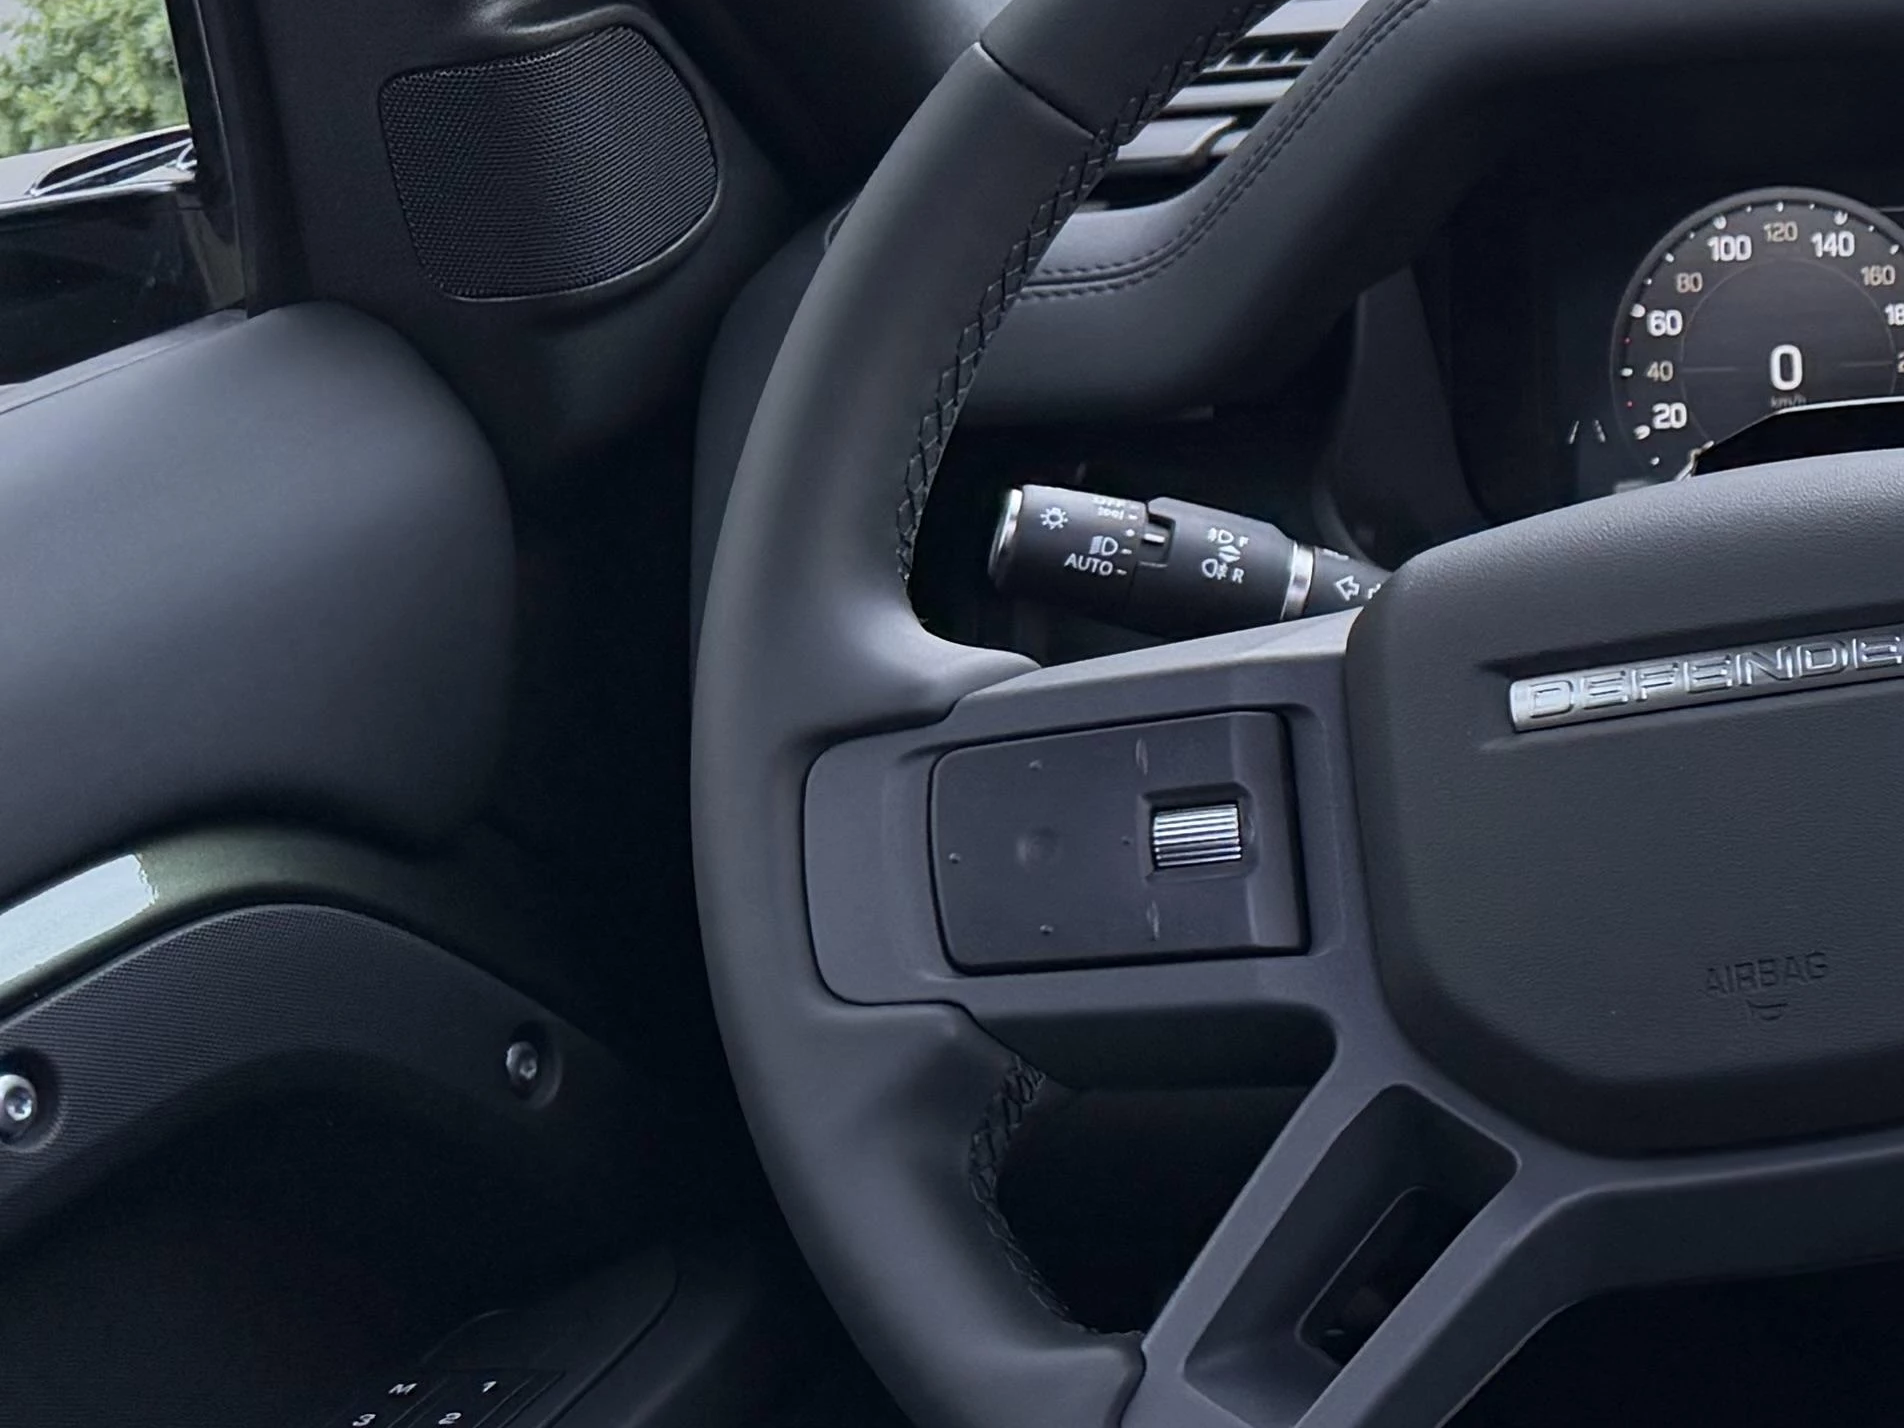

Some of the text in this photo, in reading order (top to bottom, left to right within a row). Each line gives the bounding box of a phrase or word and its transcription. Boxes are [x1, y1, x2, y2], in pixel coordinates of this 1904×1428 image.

[1763, 221, 1799, 243] 120
[1706, 234, 1753, 262] 100
[1811, 230, 1856, 258] 140
[1676, 272, 1703, 293] 80
[1860, 264, 1897, 286] 160
[1646, 308, 1683, 337] 60
[1646, 360, 1674, 383] 40
[1769, 344, 1804, 392] 0
[1651, 402, 1688, 429] 20
[1237, 535, 1250, 548] F
[1063, 553, 1113, 576] AUTO
[1231, 569, 1245, 584] R
[1704, 951, 1828, 994] AIRBAG
[352, 1413, 376, 1426] 3
[438, 1412, 462, 1425] 2
